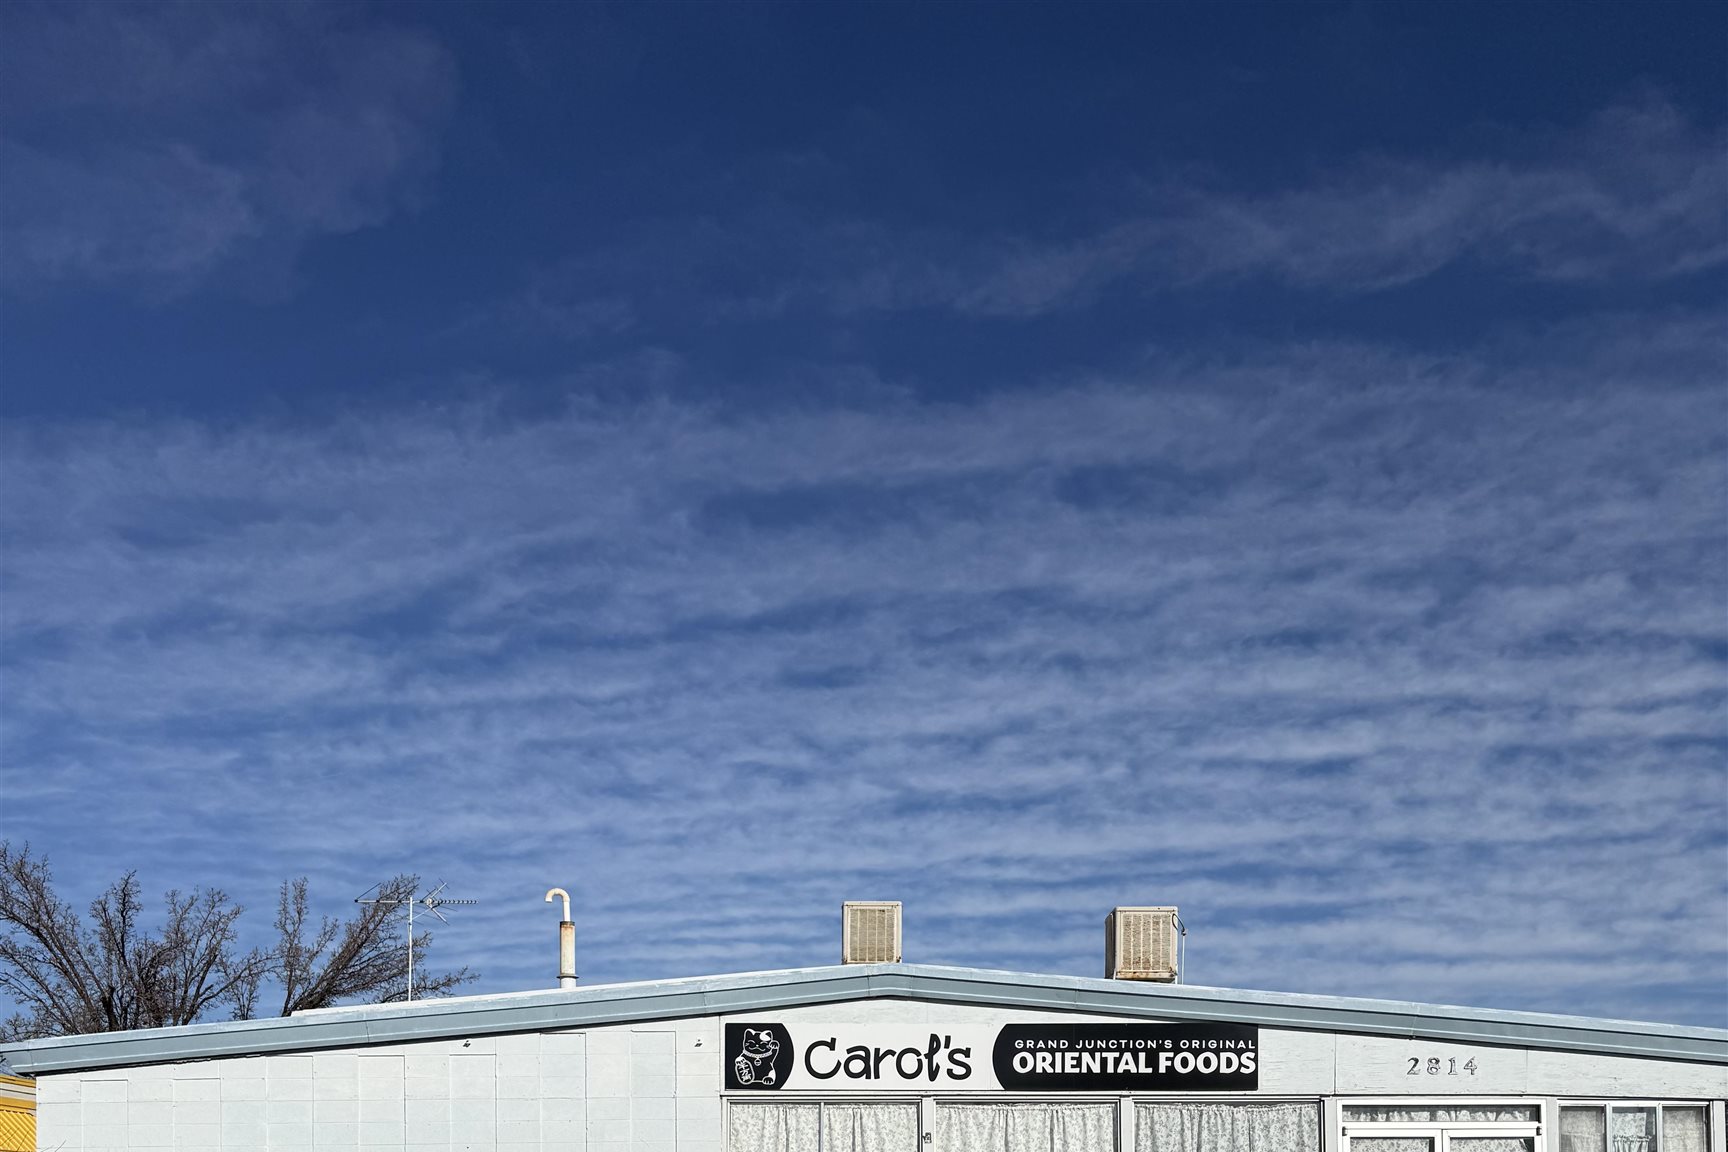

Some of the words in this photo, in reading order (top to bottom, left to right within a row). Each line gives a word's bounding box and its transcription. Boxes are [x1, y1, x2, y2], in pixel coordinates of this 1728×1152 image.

[1014, 1039, 1069, 1049] GRAND
[1075, 1039, 1173, 1049] JUNCTION'S
[1179, 1039, 1256, 1049] ORIGINAL
[804, 1033, 972, 1082] Carol's
[1012, 1051, 1153, 1074] ORIENTAL
[1158, 1051, 1257, 1075] FOODS
[1406, 1056, 1478, 1076] 2814
